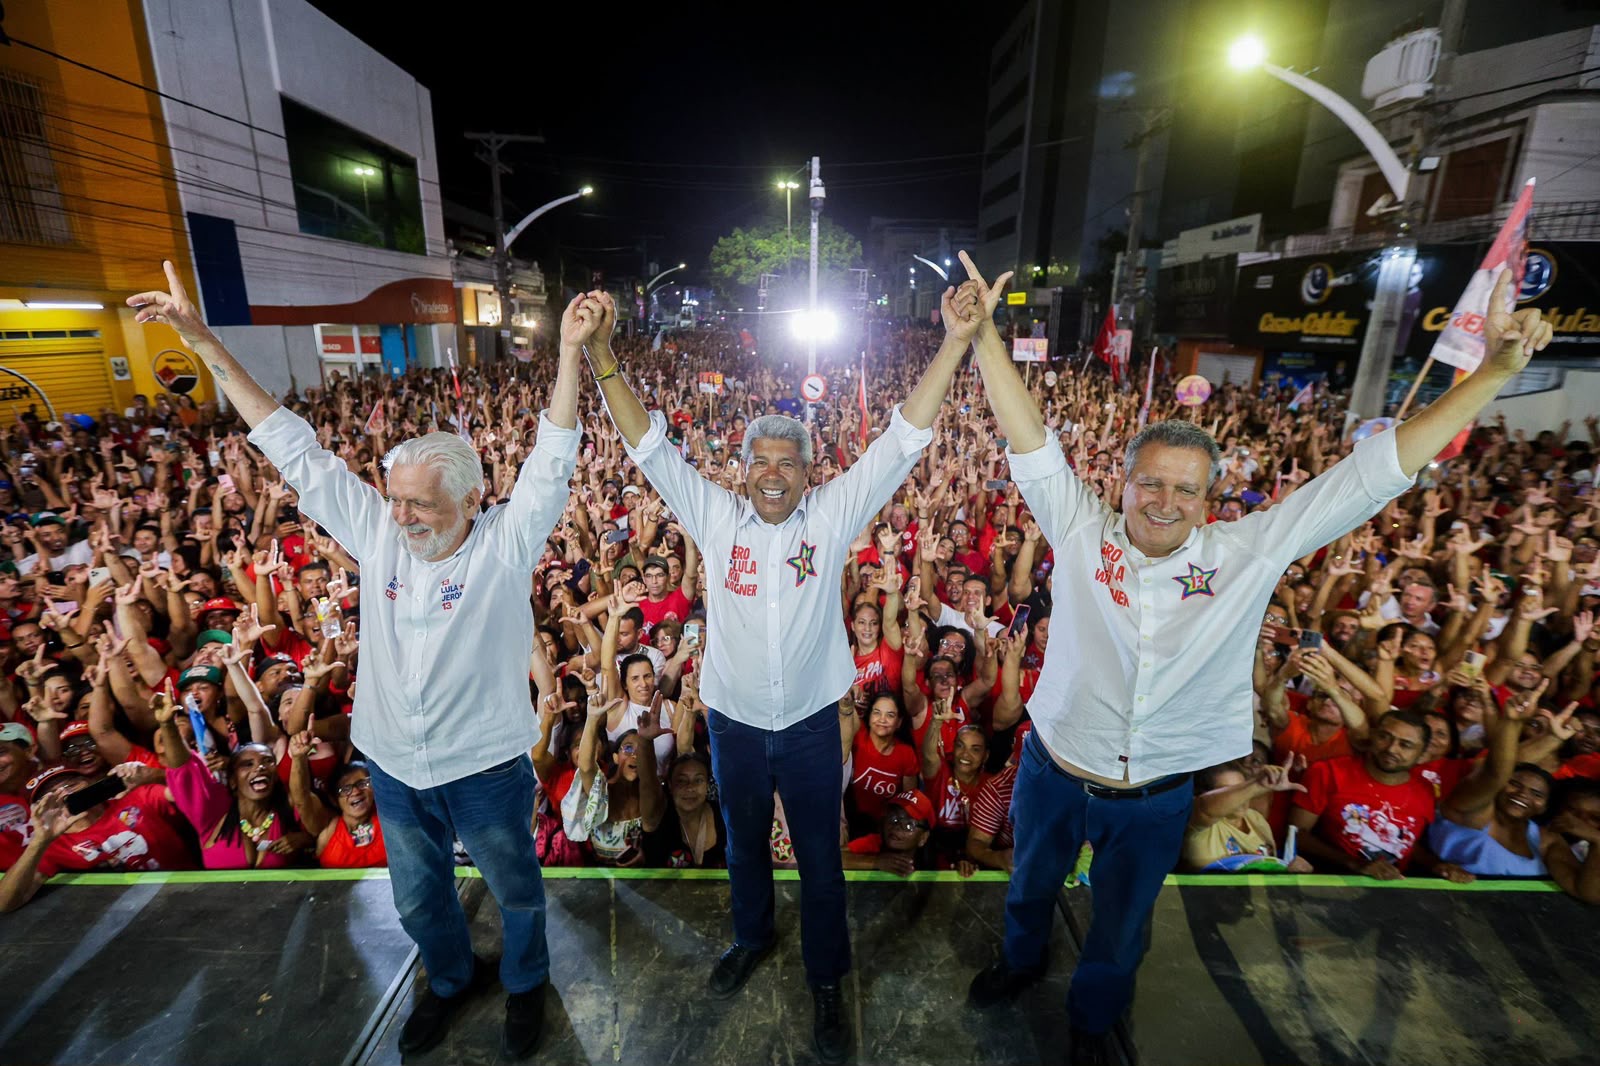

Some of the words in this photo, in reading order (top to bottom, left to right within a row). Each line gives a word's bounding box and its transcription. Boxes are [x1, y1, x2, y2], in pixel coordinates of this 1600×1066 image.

[733, 560, 757, 575] LULA
[440, 584, 459, 594] LULA
[1191, 575, 1204, 589] 13
[441, 602, 453, 611] 13
[863, 775, 897, 799] 169
